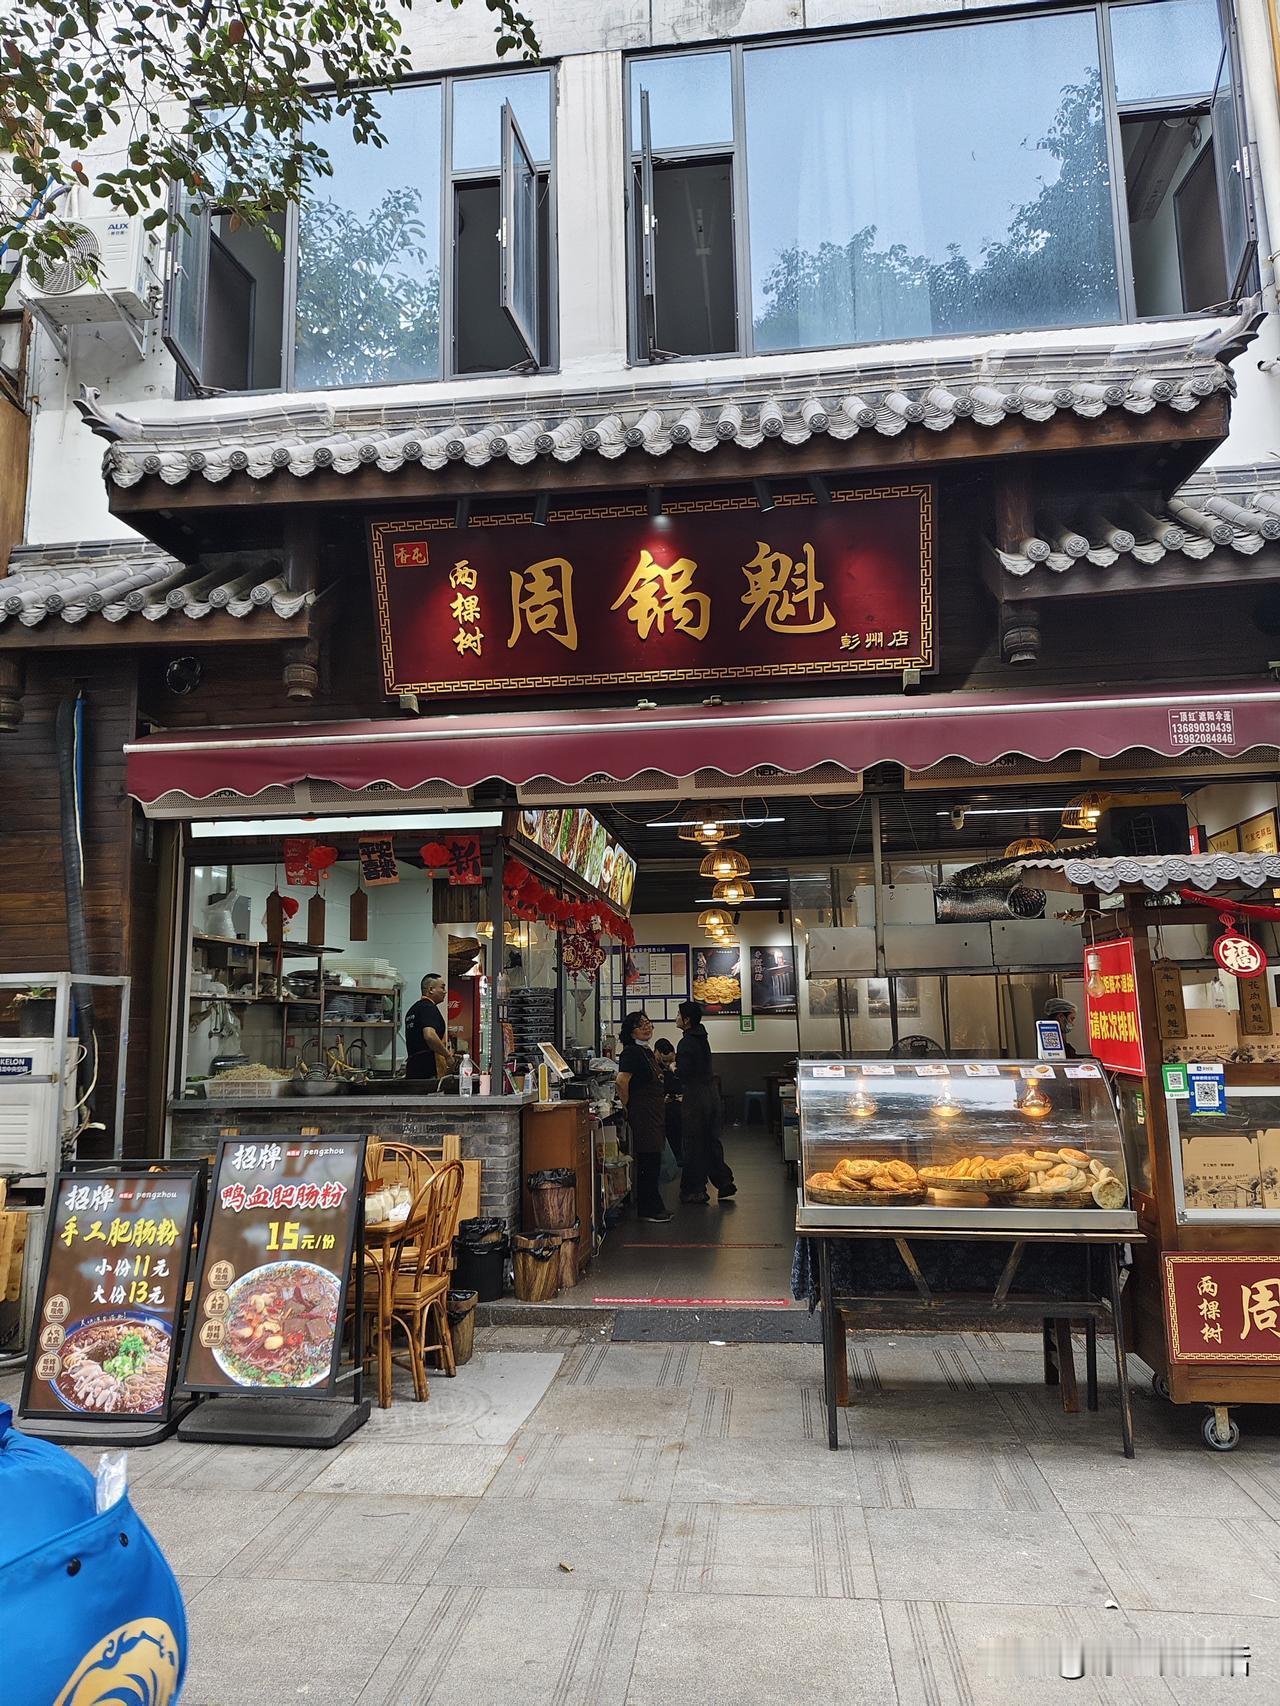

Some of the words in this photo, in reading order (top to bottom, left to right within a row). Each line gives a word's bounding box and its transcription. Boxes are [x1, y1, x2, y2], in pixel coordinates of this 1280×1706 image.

[448, 560, 484, 658] 两棵树
[507, 541, 837, 652] 周锅魁
[839, 630, 910, 651] 彭州店
[1172, 722, 1232, 733] 13689030439
[1173, 733, 1233, 744] 13982084846
[1223, 941, 1258, 968] 福
[1090, 1010, 1139, 1043] 请依次排队
[231, 1142, 282, 1171] 招牌
[303, 1147, 345, 1158] pengzhou
[65, 1184, 115, 1213] 招牌
[135, 1190, 177, 1200] pengzhou
[219, 1181, 348, 1213] 鸭血肥肠粉
[61, 1215, 181, 1248] 手工肥肠粉
[265, 1221, 336, 1251] 15元/份
[94, 1255, 170, 1277] 小份11元
[91, 1281, 165, 1305] 大份13元
[1197, 1275, 1223, 1344] 两棵树
